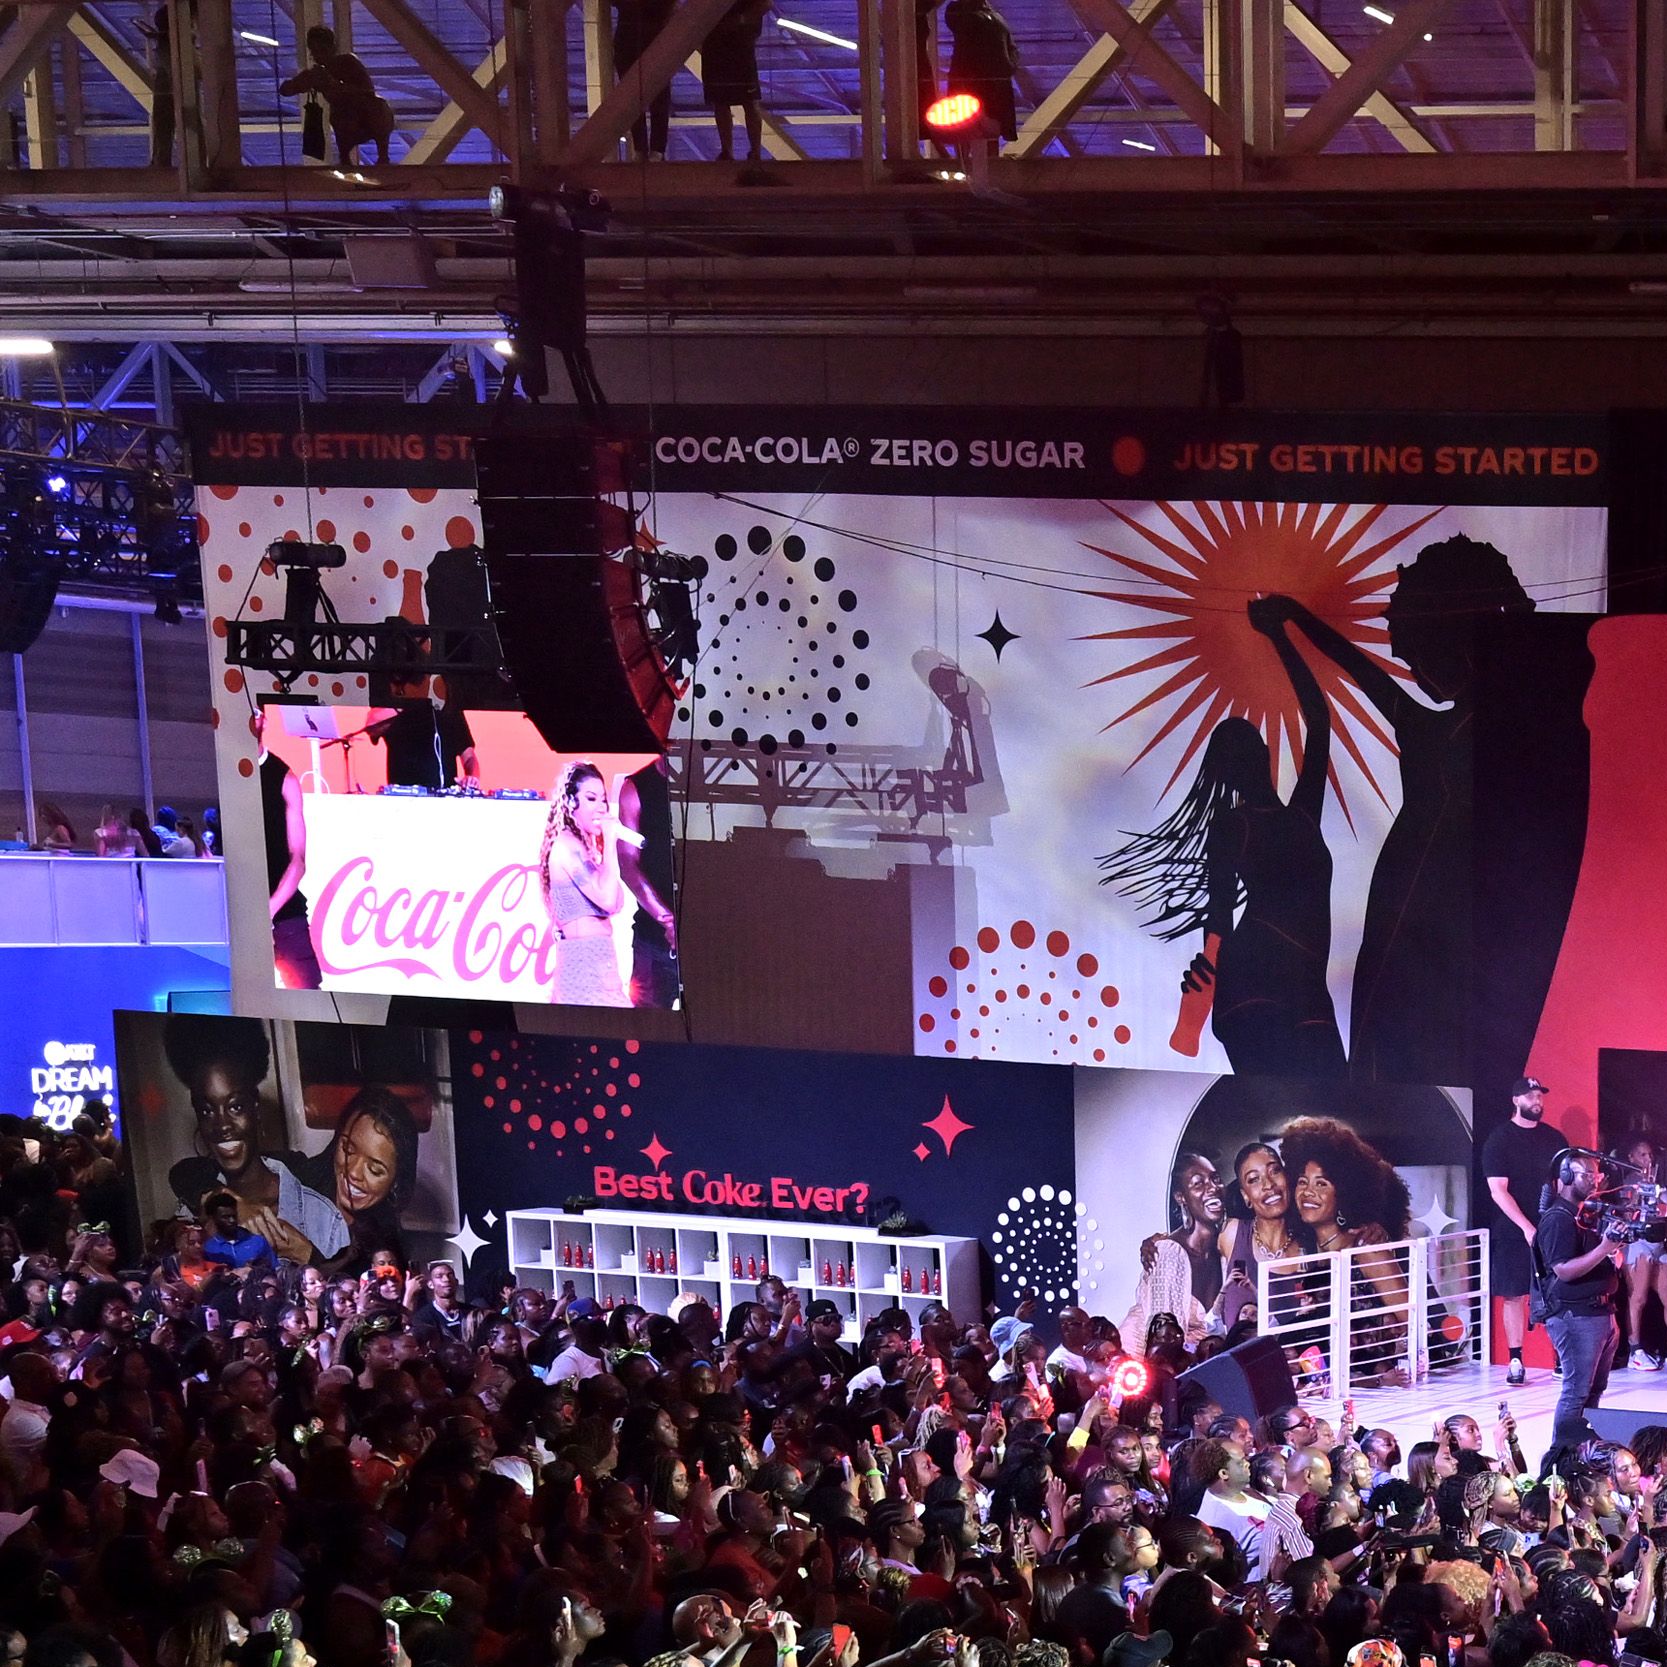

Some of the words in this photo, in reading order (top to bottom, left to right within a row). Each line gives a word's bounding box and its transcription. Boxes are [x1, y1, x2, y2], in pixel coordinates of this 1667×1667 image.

[209, 431, 283, 459] JUST
[292, 433, 426, 462] GETTING
[870, 438, 959, 467] ZERO
[969, 441, 1086, 469] SUGAR
[1173, 442, 1260, 472] JUST
[1269, 444, 1424, 475] GETTING
[1434, 446, 1600, 476] STARTED
[31, 1065, 113, 1094] DREAM
[593, 1165, 674, 1201] Best
[682, 1169, 763, 1208] Coke
[770, 1176, 871, 1214] Ever?
